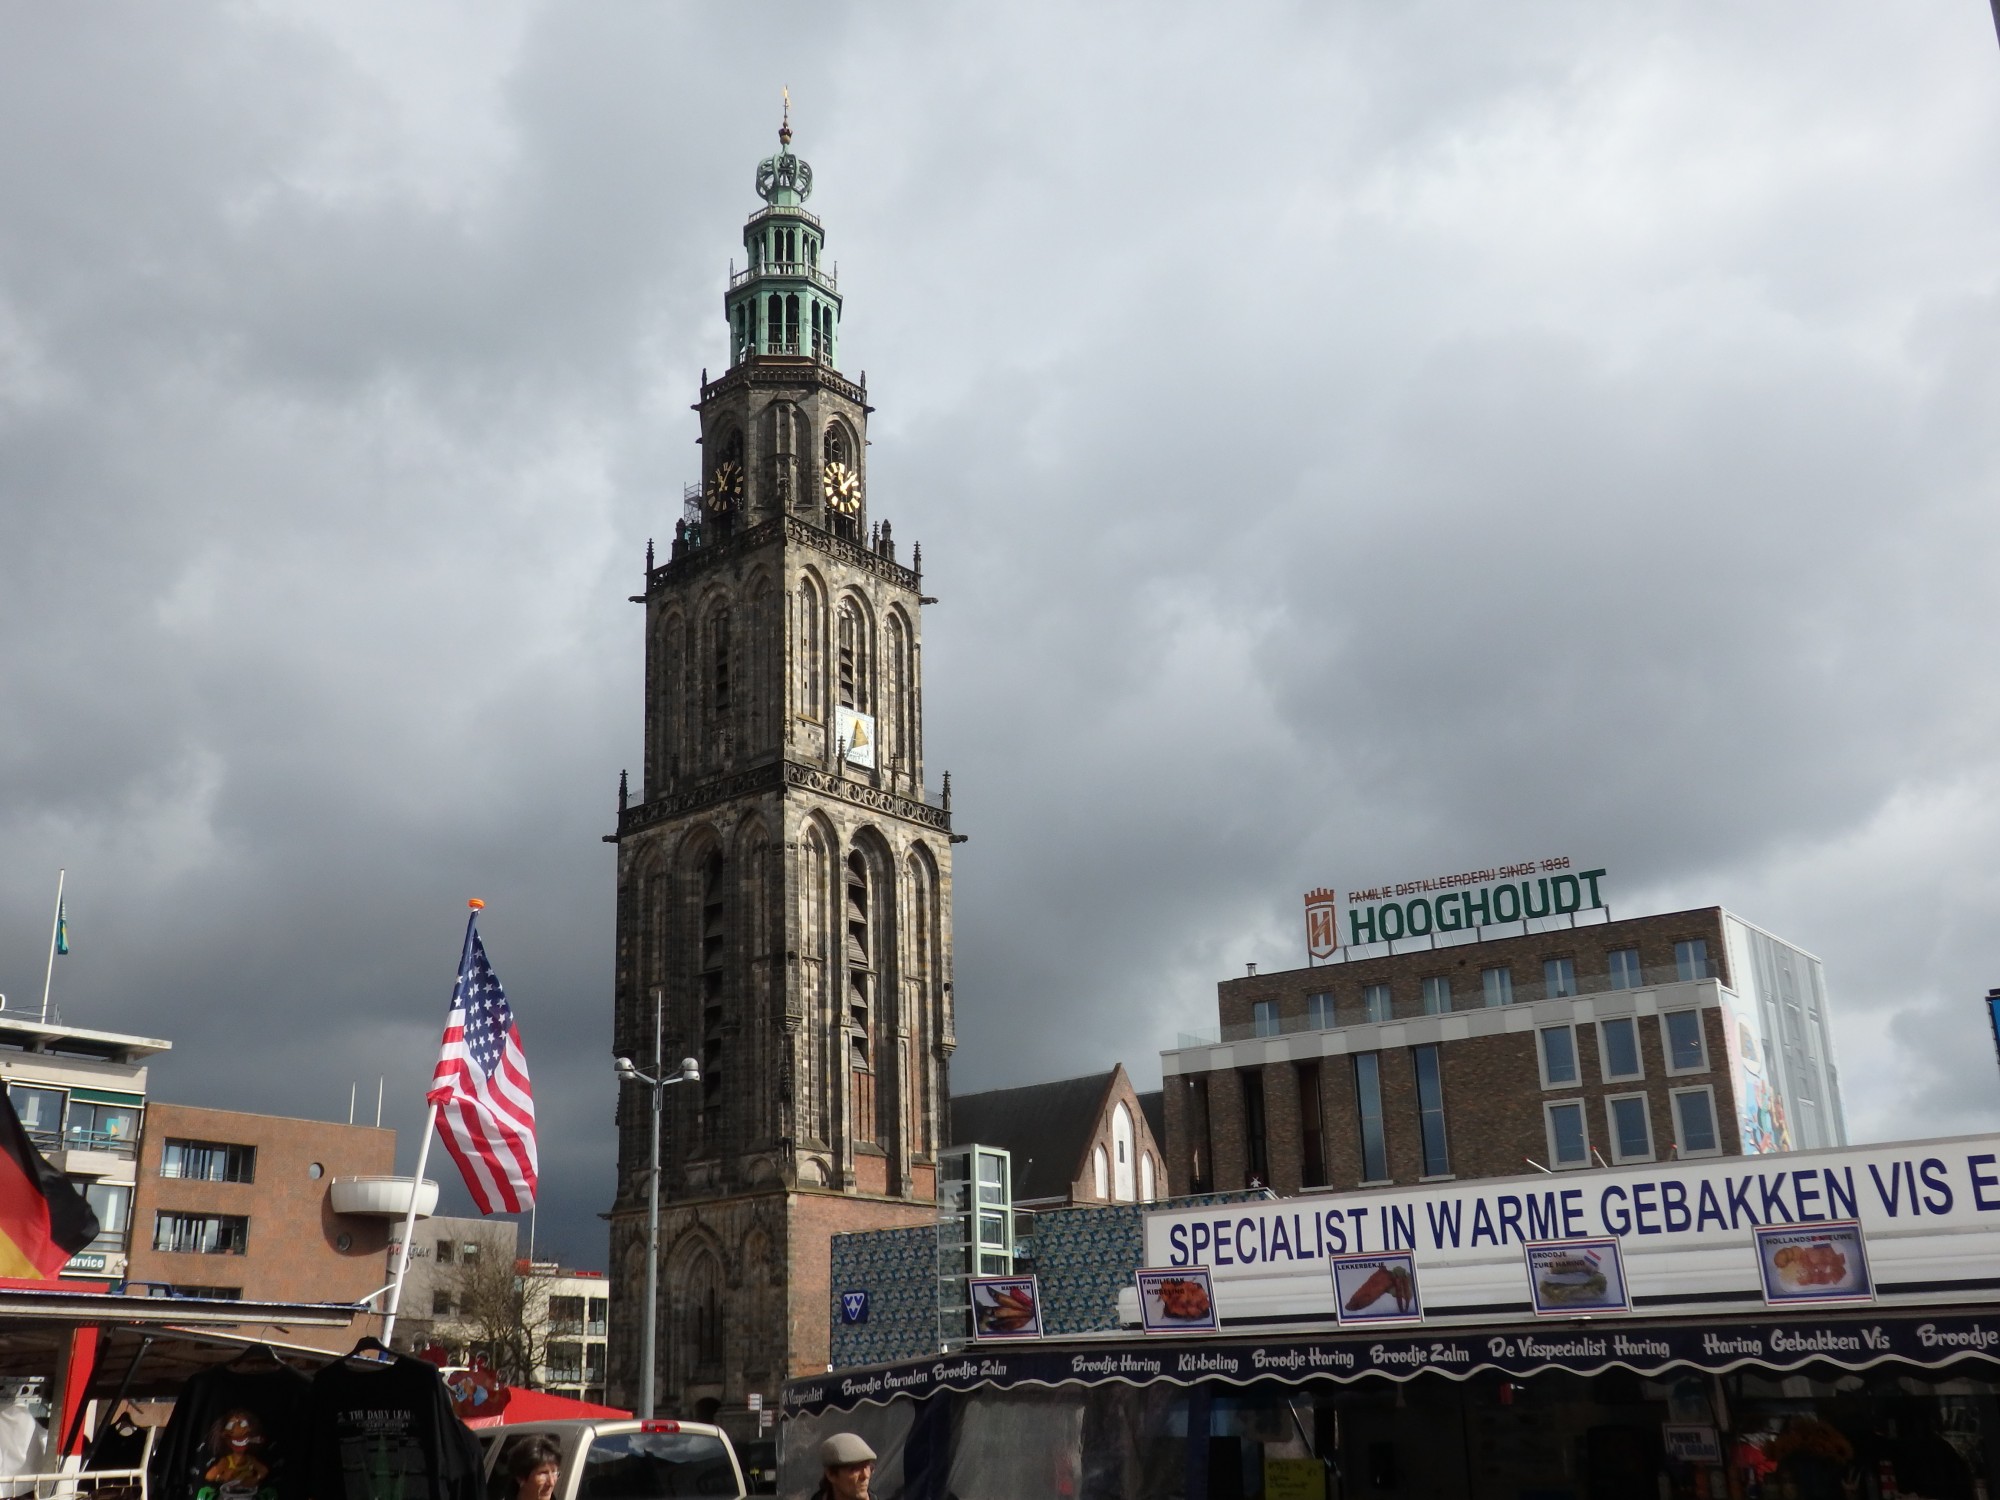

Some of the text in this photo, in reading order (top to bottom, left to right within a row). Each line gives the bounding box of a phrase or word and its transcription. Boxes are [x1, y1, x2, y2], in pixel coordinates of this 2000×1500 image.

[1349, 886, 1393, 904] FAMILIE
[1396, 869, 1495, 895] DISTILLEERDERIJ
[1499, 862, 1536, 879] SINDS
[1349, 868, 1607, 945] HOOGHOUDT
[1170, 1207, 1369, 1266] SPECIALIST
[1381, 1203, 1416, 1251] IN
[1427, 1188, 1588, 1249] WARME
[1600, 1166, 1860, 1238] GEBAKKEN
[1868, 1158, 1954, 1216] VIS
[1337, 1261, 1385, 1271] LEKKERBEKJE
[1532, 1250, 1567, 1259] BROODJE
[1488, 1335, 1670, 1360] De Visspecialist Haring
[1703, 1326, 1891, 1356] Haring Gebakken Vis
[1917, 1323, 2000, 1350] Broodje
[1071, 1354, 1161, 1375] Broodje Haring
[1178, 1353, 1239, 1373] Kibbeling
[1252, 1347, 1354, 1370] Broodje Haring
[1370, 1343, 1470, 1367] Broodje Zalm
[932, 1360, 978, 1381] Broodje
[841, 1370, 928, 1396] Broodje Garnalen
[367, 1409, 389, 1420] DAILY
